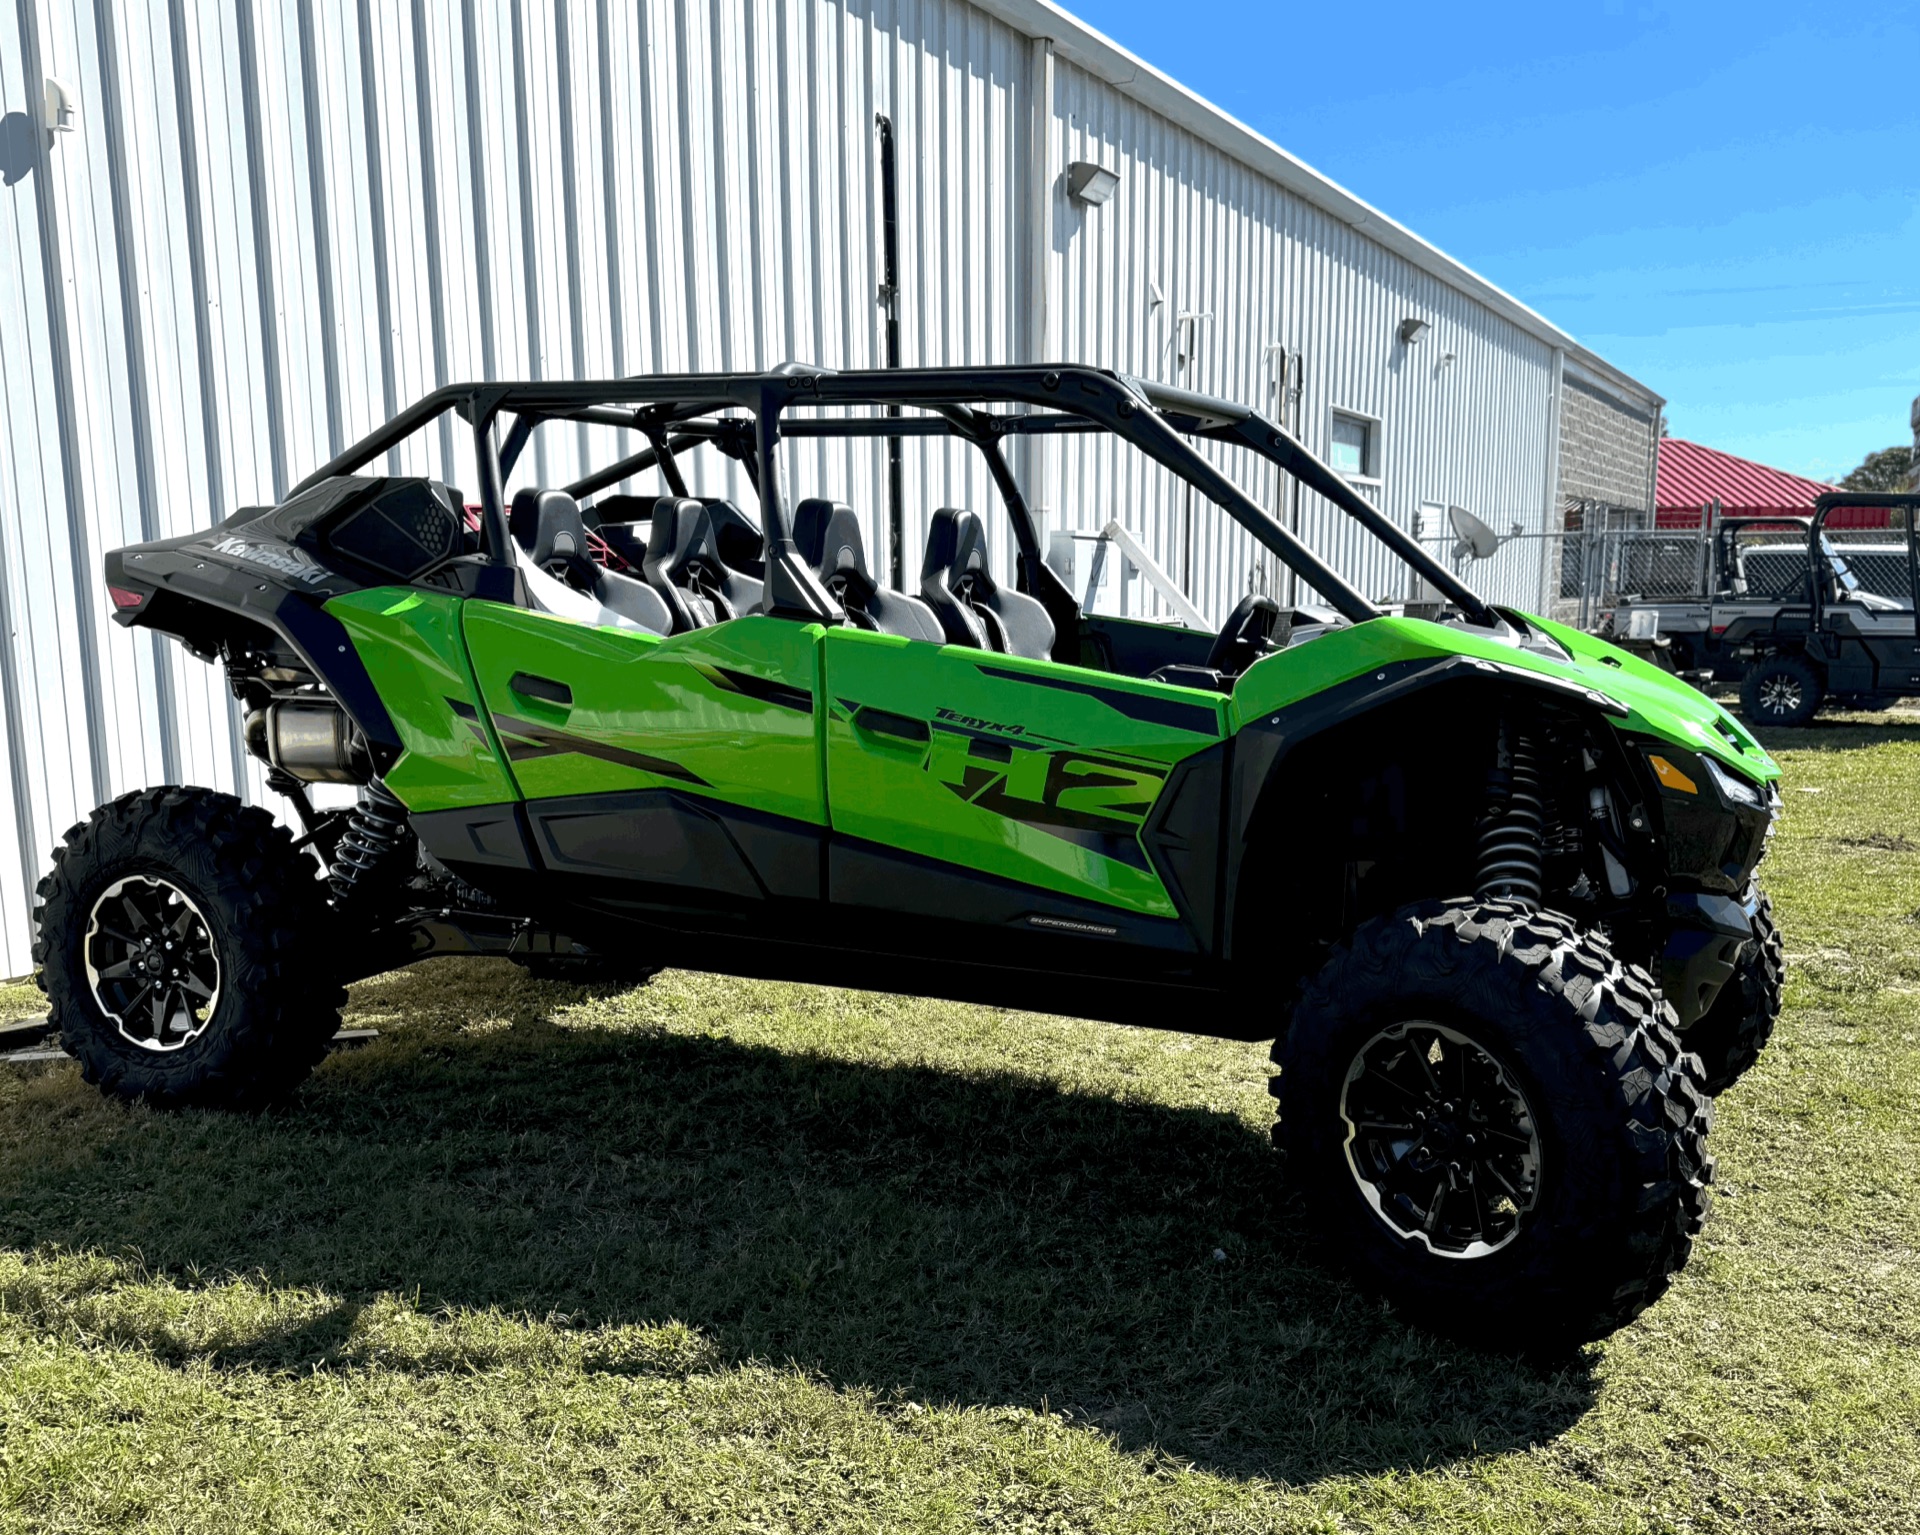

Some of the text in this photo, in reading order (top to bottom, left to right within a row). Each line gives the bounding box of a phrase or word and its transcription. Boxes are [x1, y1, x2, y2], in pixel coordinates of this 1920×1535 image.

[211, 537, 335, 585] Kawasaki
[930, 730, 1168, 825] H2
[1030, 917, 1118, 934] SUPERCHARGED
